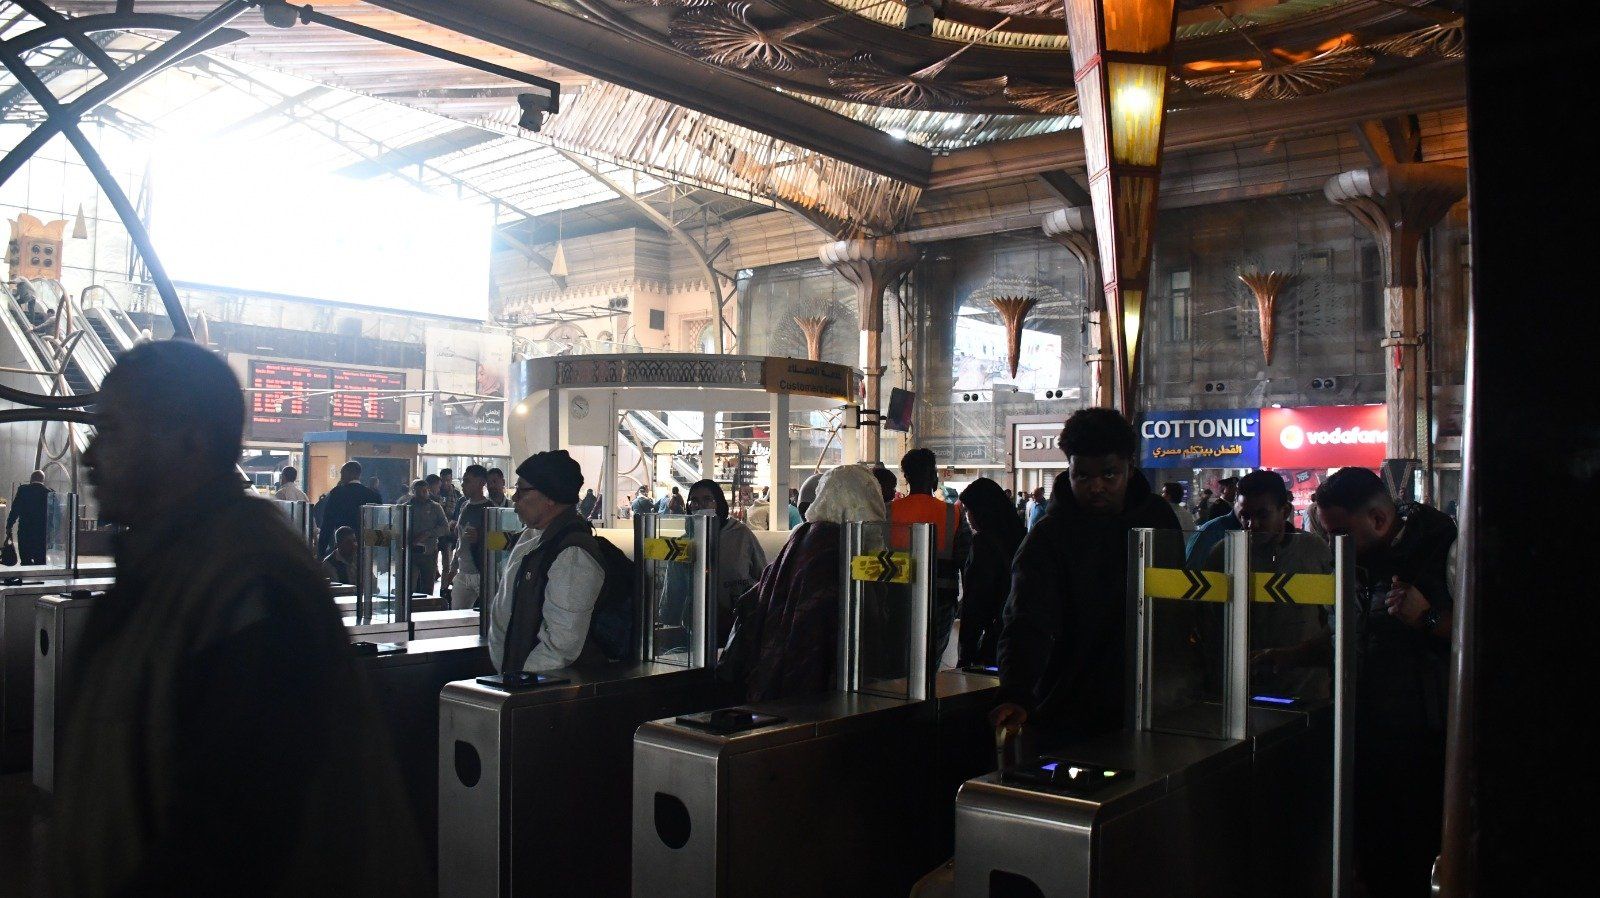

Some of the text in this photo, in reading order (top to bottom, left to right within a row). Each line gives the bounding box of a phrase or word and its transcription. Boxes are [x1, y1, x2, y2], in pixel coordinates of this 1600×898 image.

[1141, 418, 1256, 439] COTTONIL
[1152, 446, 1182, 458] مصري
[1214, 444, 1242, 457] القطن
